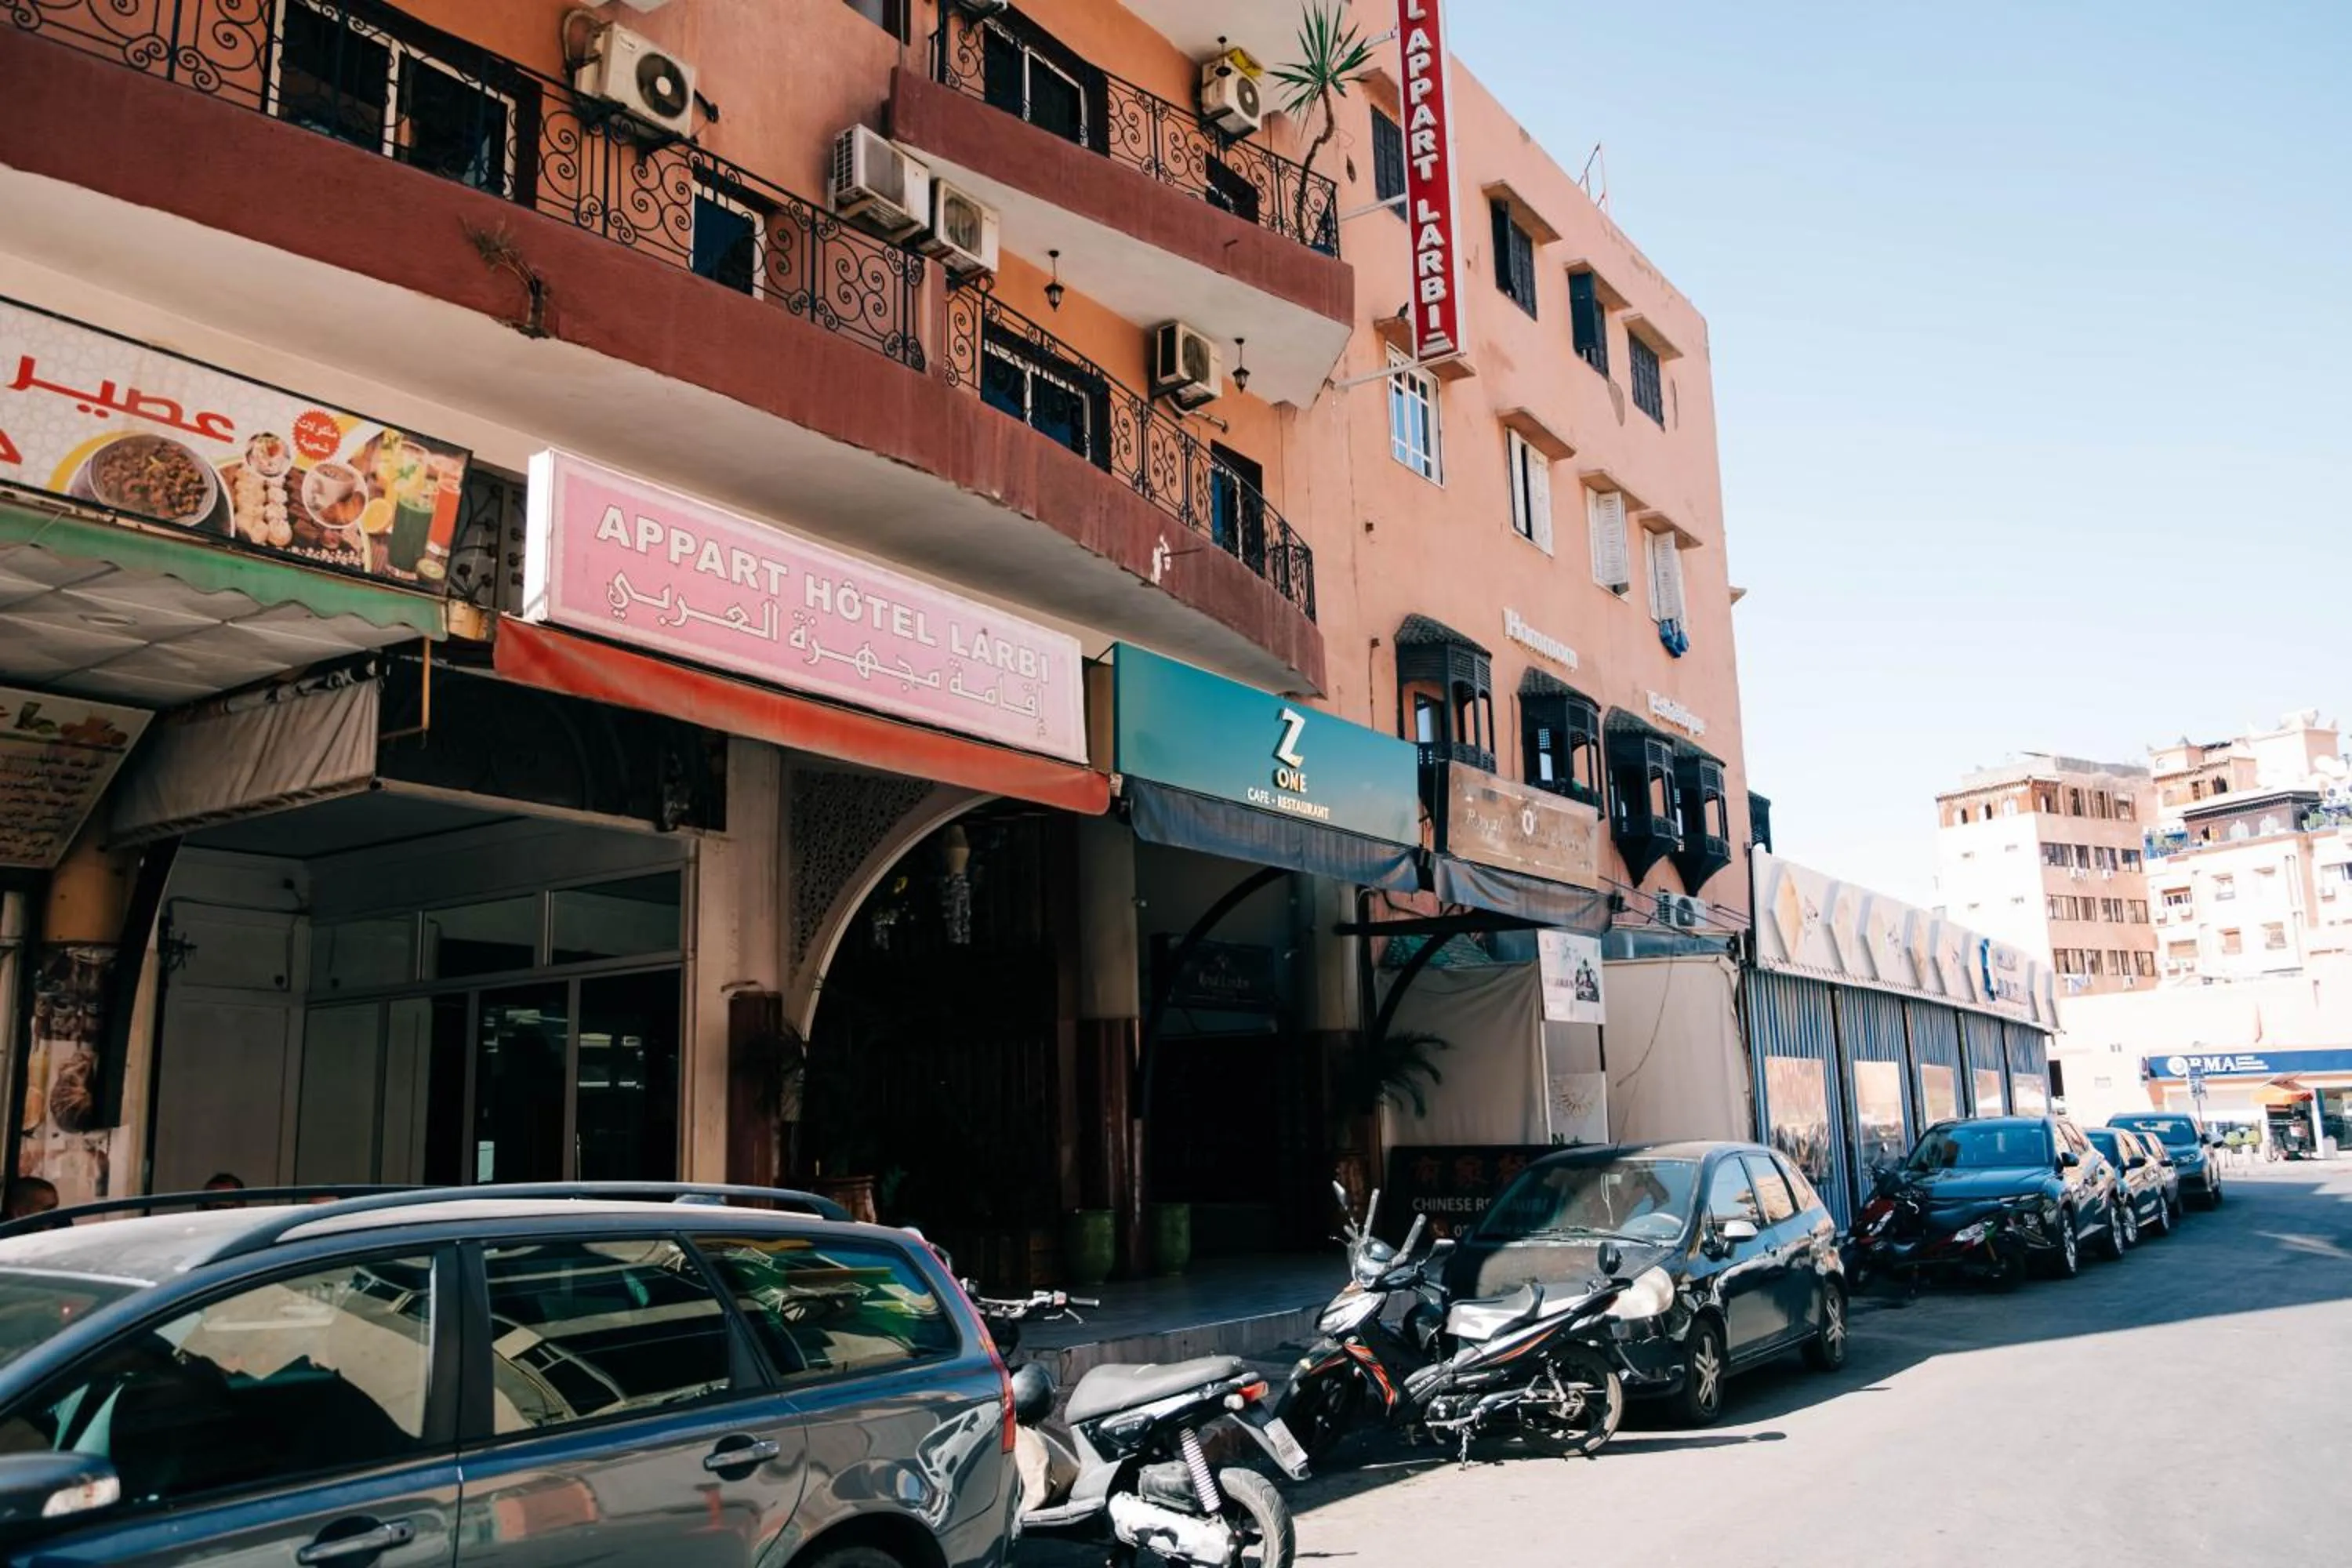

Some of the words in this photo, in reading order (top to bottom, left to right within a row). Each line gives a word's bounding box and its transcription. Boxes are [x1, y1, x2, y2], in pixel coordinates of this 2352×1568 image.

[1417, 198, 1446, 329] LARBI
[7, 354, 235, 444] عصير
[595, 504, 788, 597] APPART
[804, 572, 938, 648] HÔTEL
[949, 621, 1050, 684] LARBI
[606, 570, 780, 642] العربي
[789, 610, 942, 693] مجهزة
[1276, 706, 1305, 768] Z
[1247, 787, 1270, 804] CAFE
[1277, 794, 1330, 819] RESTAURANT
[1276, 768, 1308, 793] ONE
[1412, 1196, 1472, 1212] CHINESE
